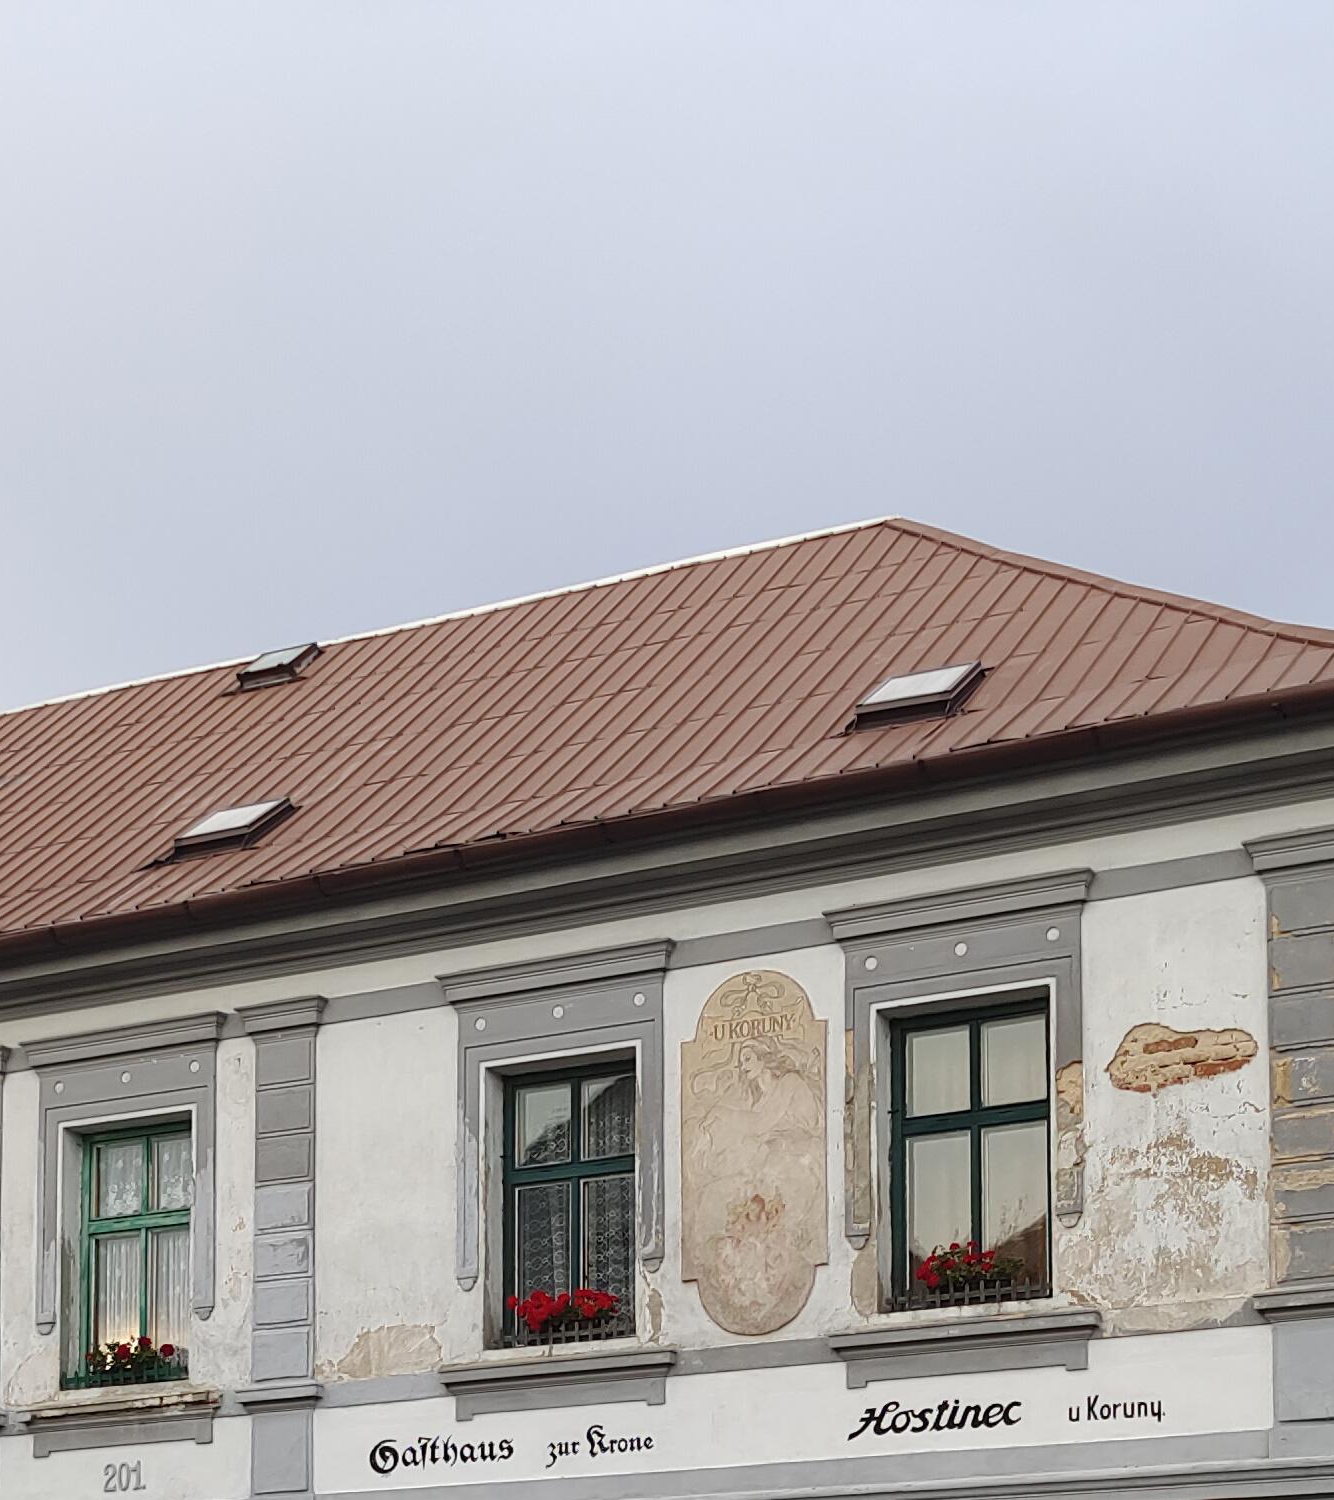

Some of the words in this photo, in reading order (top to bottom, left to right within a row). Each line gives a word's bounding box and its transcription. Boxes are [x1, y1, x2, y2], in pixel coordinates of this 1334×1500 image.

[847, 1399, 1022, 1441] Hostinec
[1068, 1406, 1080, 1422] u
[545, 1440, 581, 1469] zur
[586, 1424, 655, 1458] Krone
